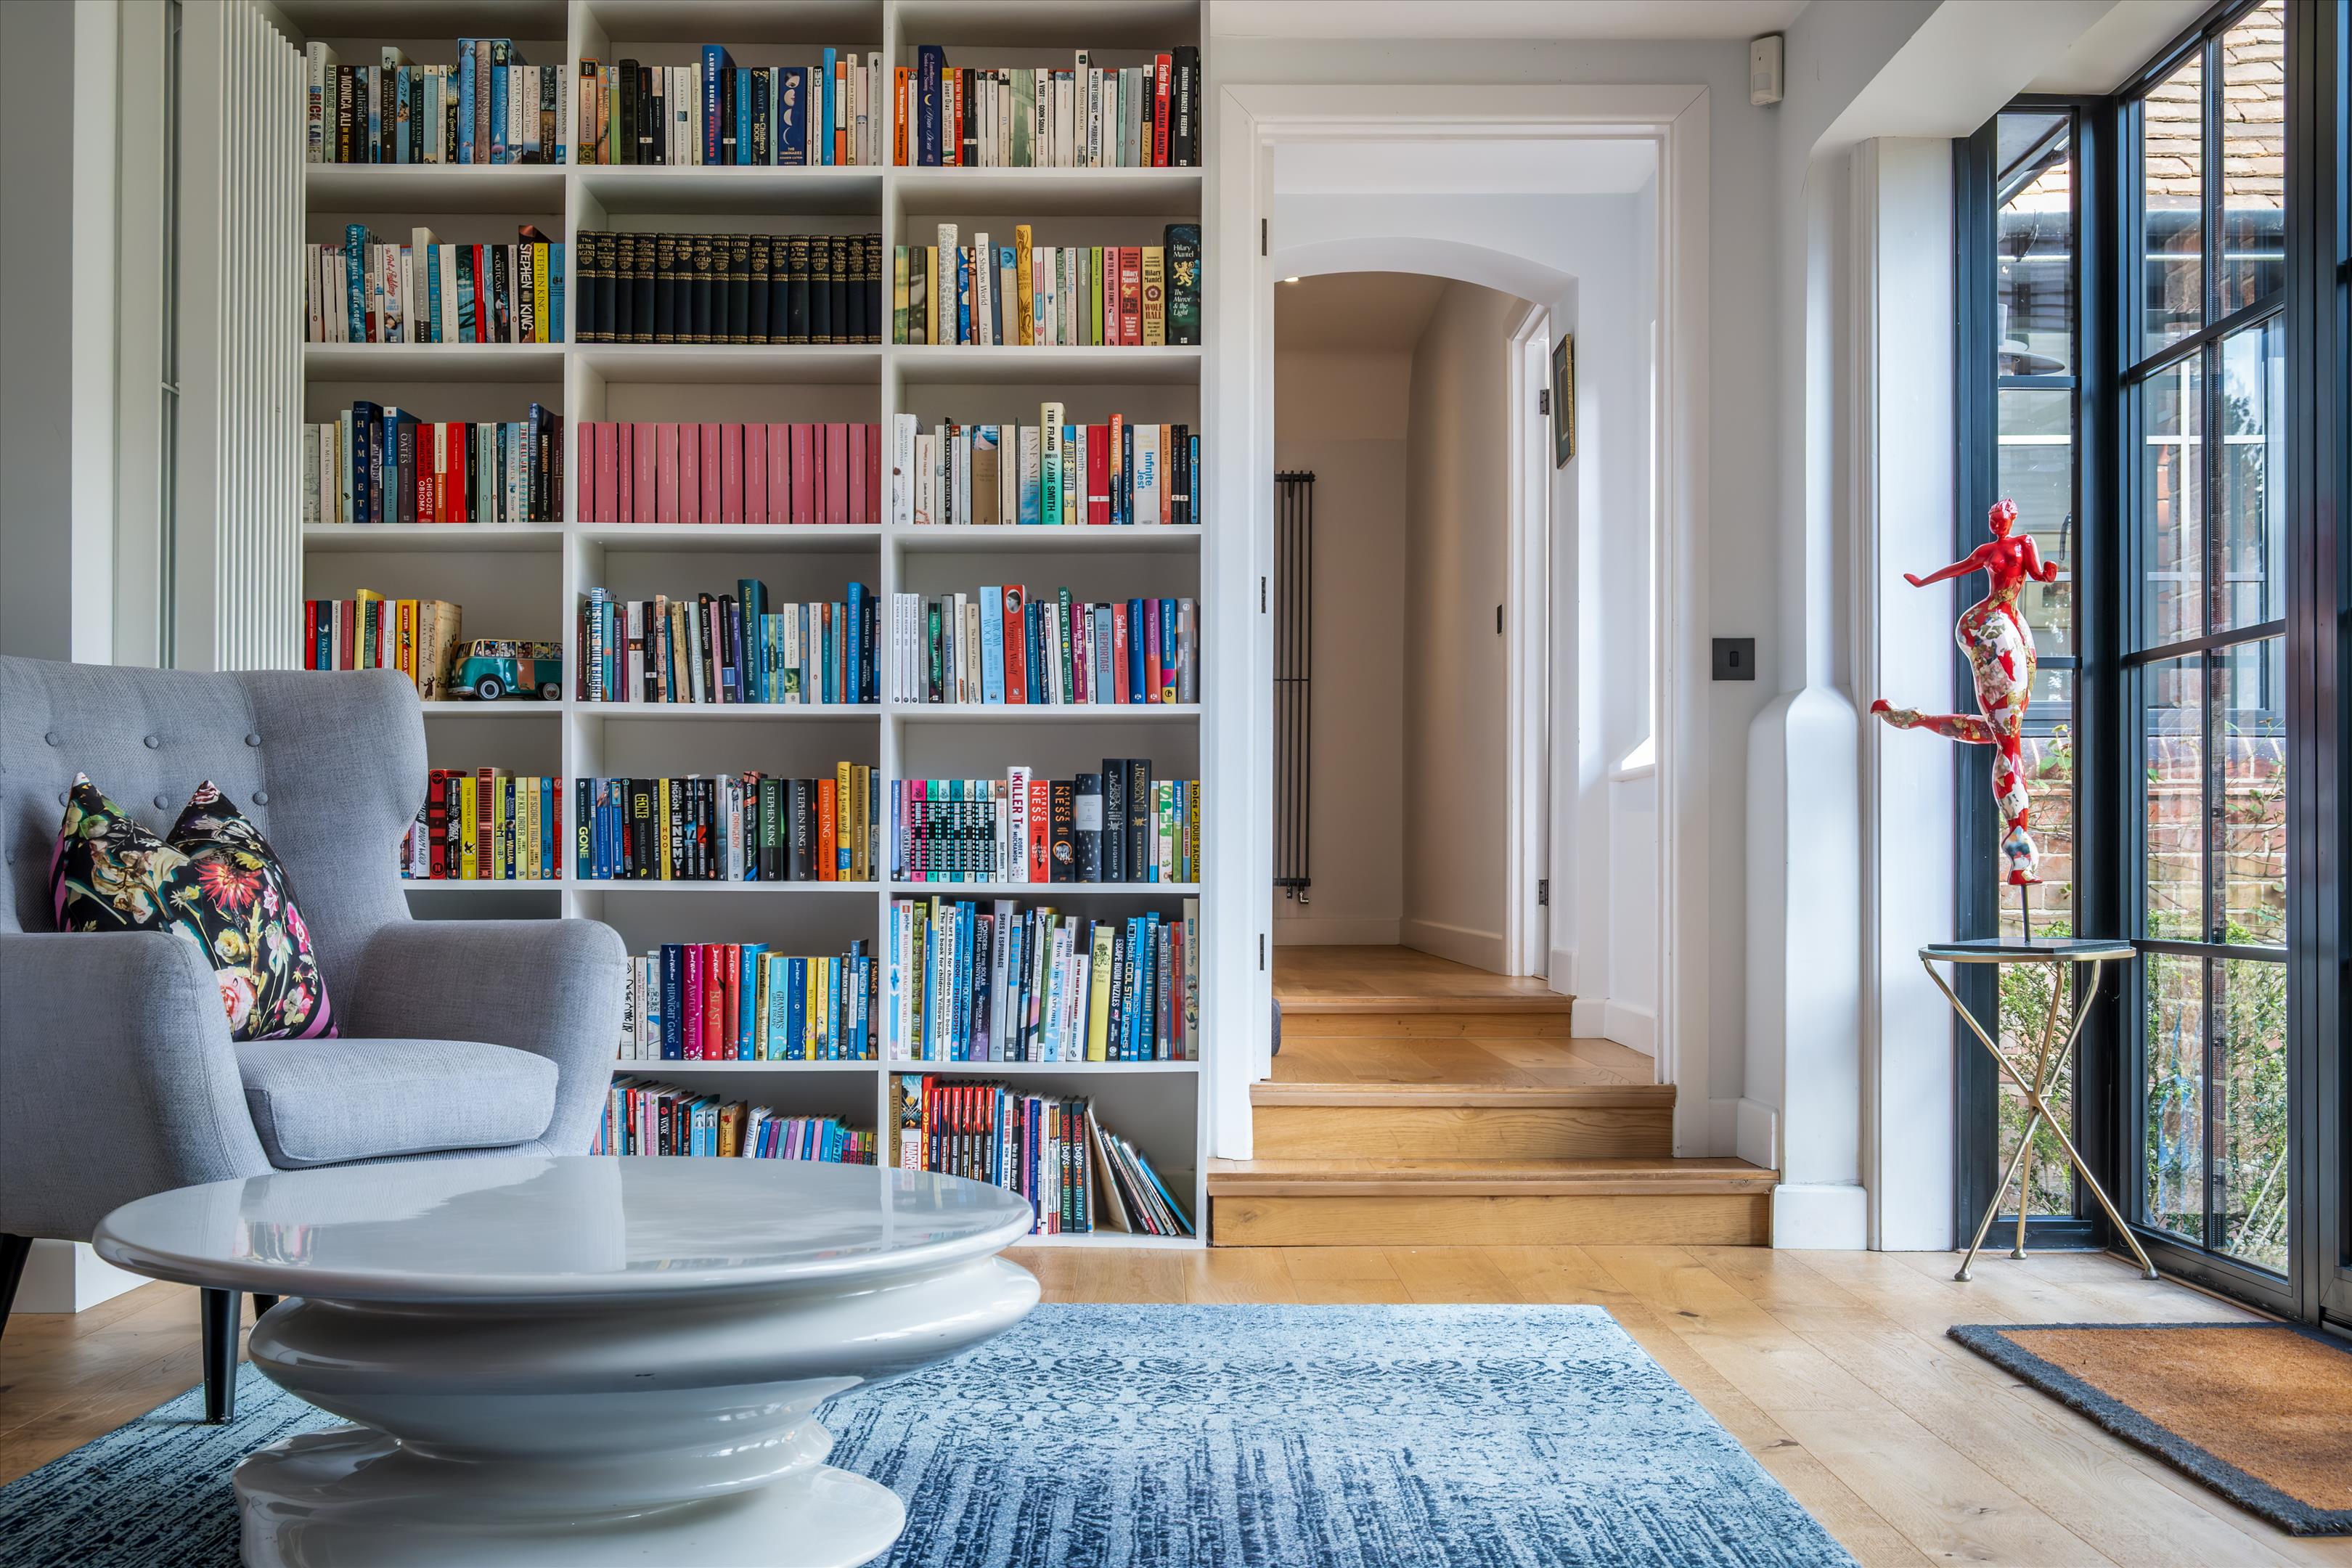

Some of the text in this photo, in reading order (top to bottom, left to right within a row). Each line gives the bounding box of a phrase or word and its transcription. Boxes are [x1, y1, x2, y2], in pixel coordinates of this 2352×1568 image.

[1159, 65, 1169, 82] Farther
[340, 75, 352, 126] MONICA ALI
[1156, 83, 1168, 96] Away
[309, 86, 322, 152] BRICK LANE
[1173, 244, 1191, 253] Hilary
[520, 244, 533, 330] STEPHEN KING
[1146, 311, 1162, 319] HALL
[1173, 309, 1188, 317] Light
[1137, 470, 1146, 489] Jest
[1145, 452, 1154, 486] Infinite
[1099, 632, 1109, 674] REPORTAGE
[636, 795, 648, 818] GONE
[1013, 775, 1023, 814] KILLER
[1032, 786, 1041, 822] NESS
[579, 826, 588, 858] GONE
[1124, 962, 1134, 984] COOL
[1112, 981, 1122, 1007] PUZZLES
[1124, 987, 1132, 1012] STUFF
[905, 1142, 918, 1169] MARVE
[1074, 1146, 1083, 1166] BOYS
